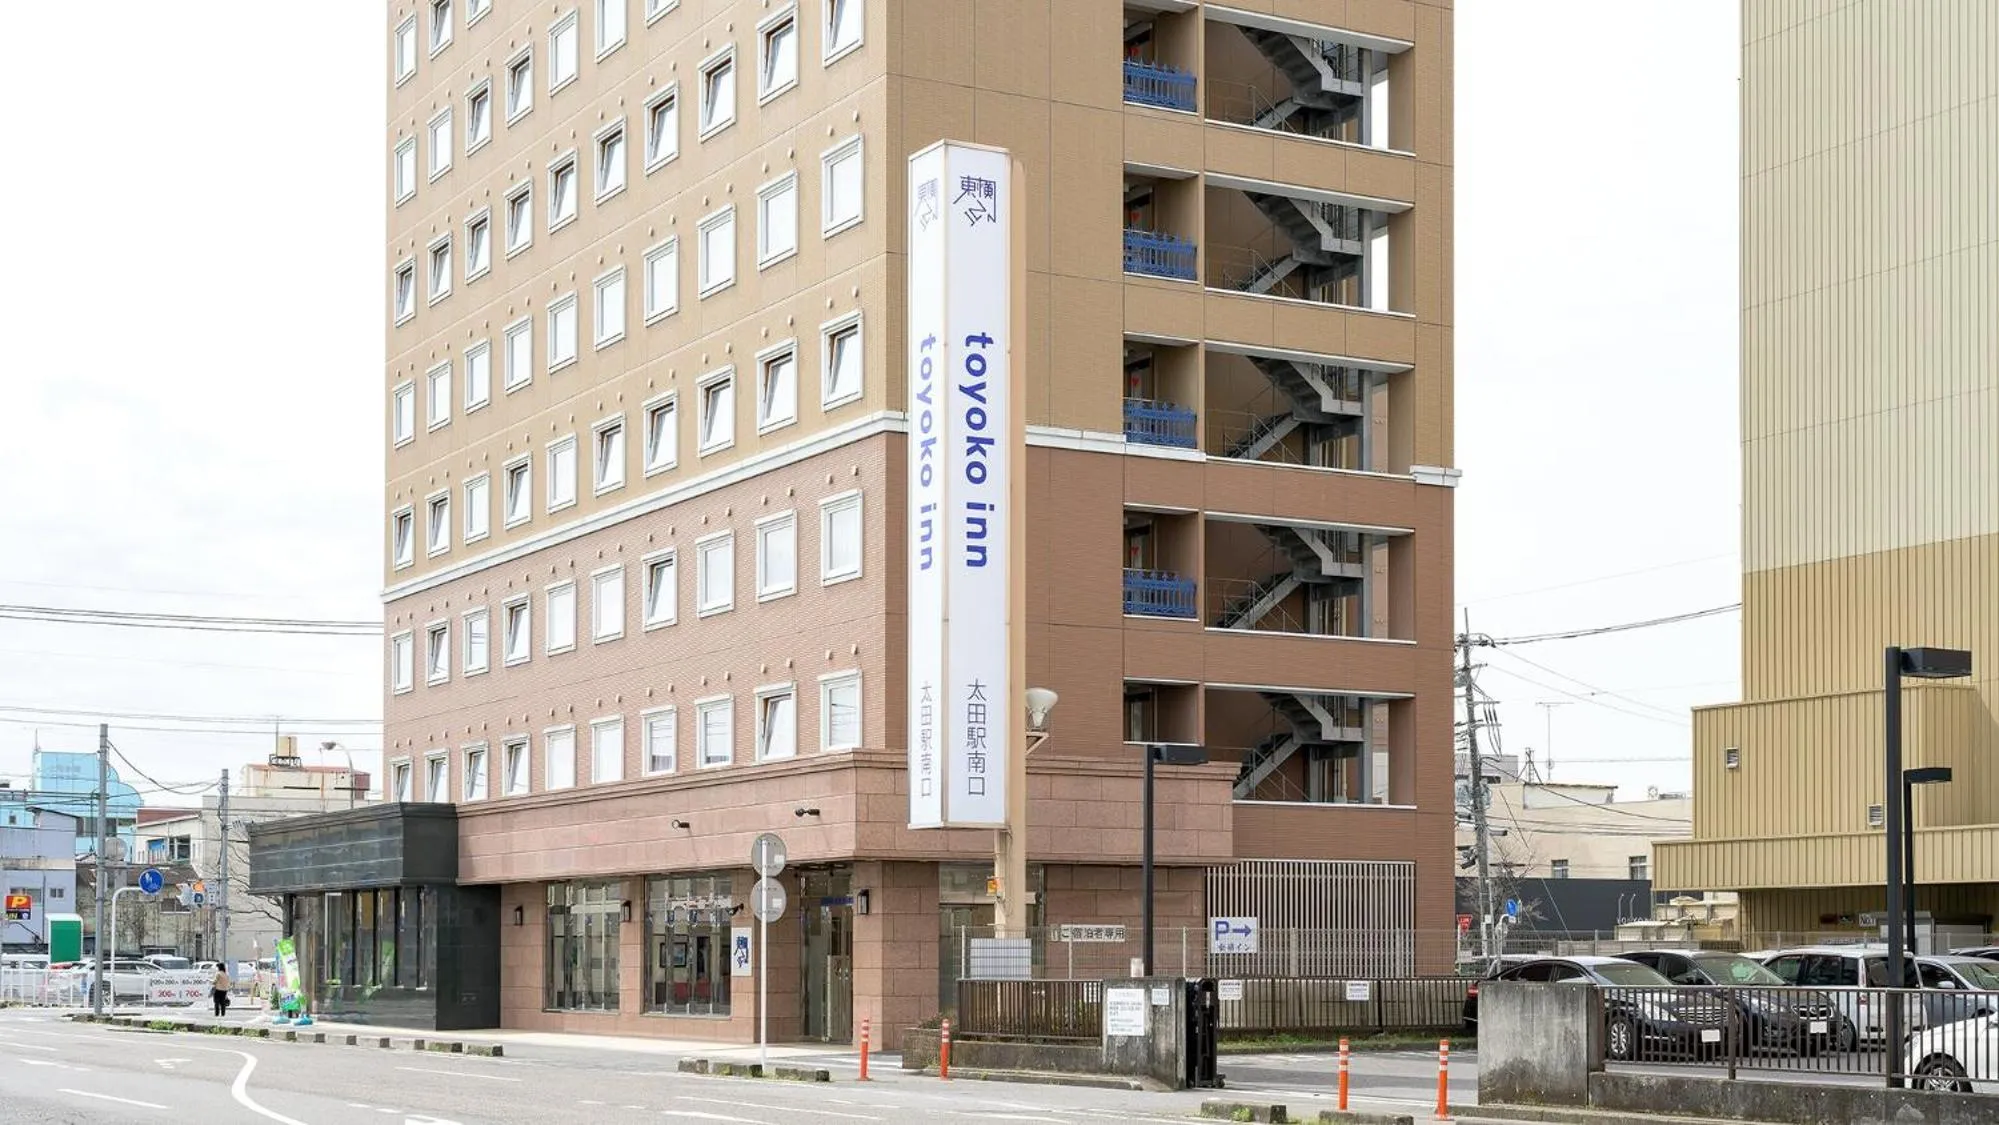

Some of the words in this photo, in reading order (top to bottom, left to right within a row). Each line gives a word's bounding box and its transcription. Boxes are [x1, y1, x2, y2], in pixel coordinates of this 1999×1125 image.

[916, 333, 937, 488] toyoko
[958, 332, 995, 485] toyoko
[920, 502, 937, 571] inn
[966, 502, 995, 568] inn
[920, 681, 933, 798] 太田駅南口
[966, 678, 988, 797] 太田駅南口
[12, 896, 28, 908] P
[1215, 921, 1230, 941] P
